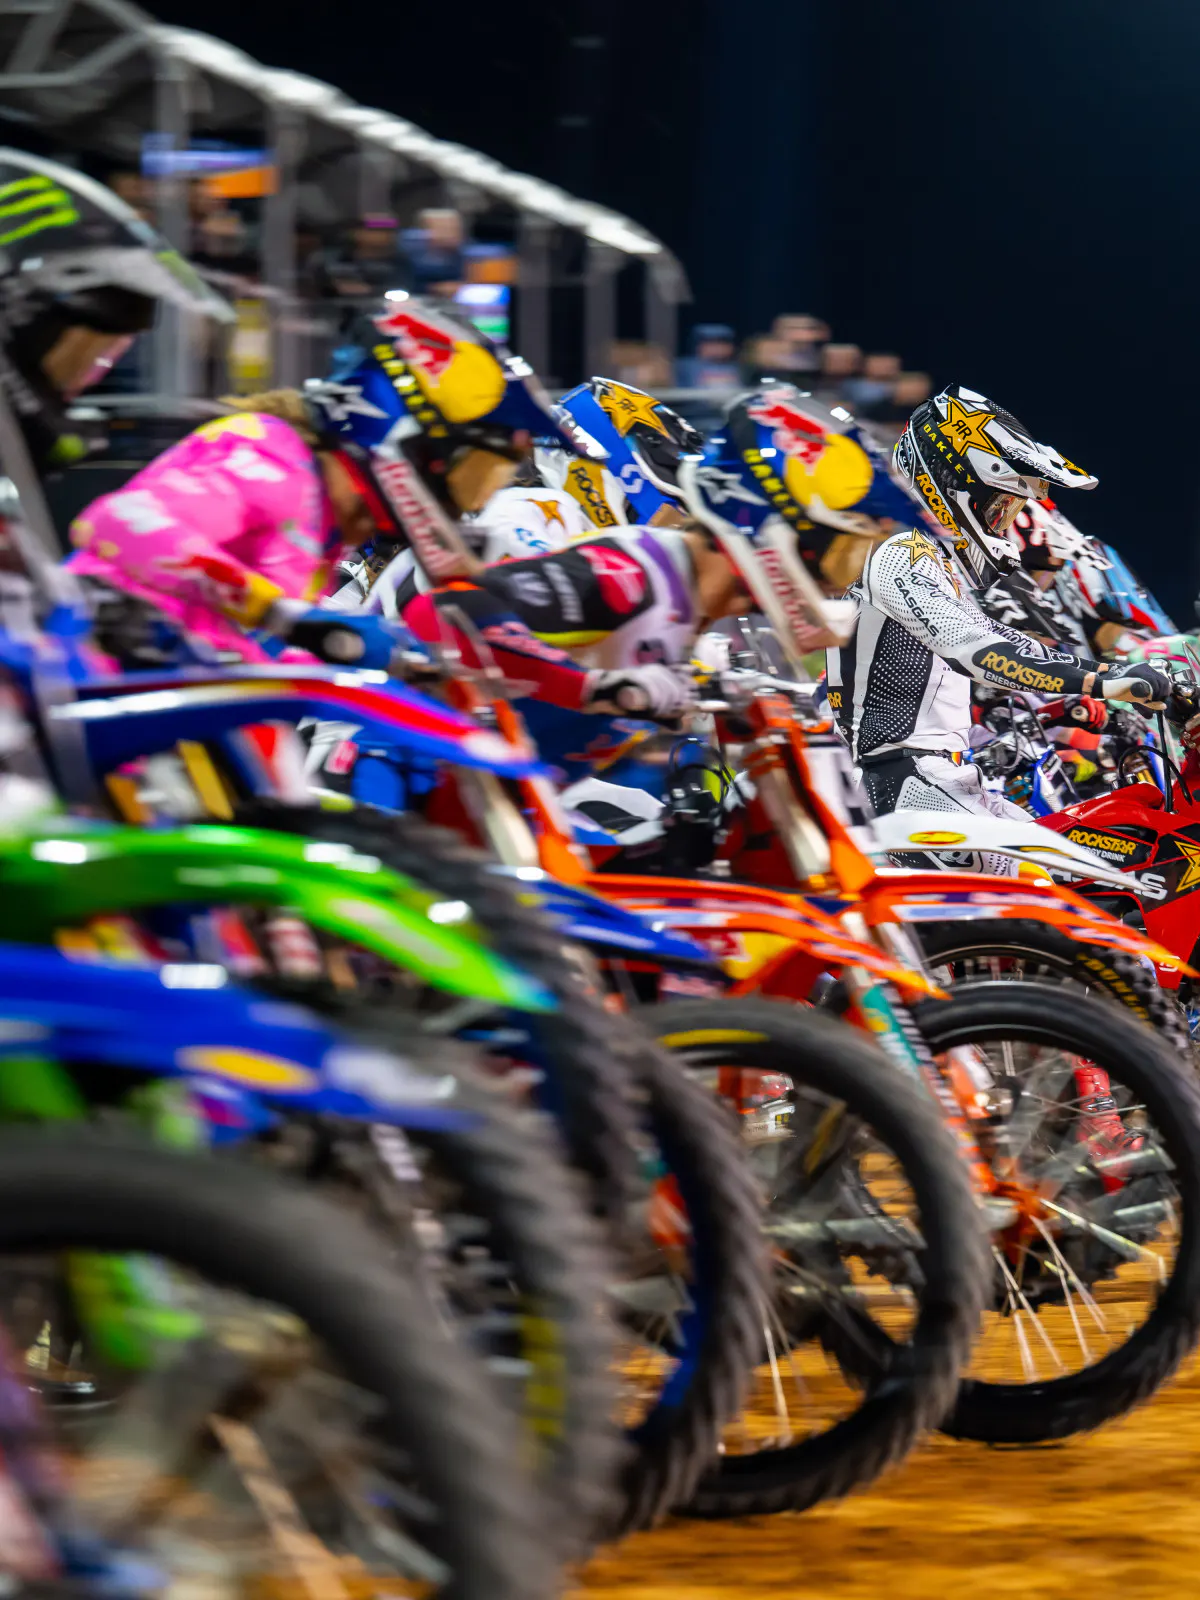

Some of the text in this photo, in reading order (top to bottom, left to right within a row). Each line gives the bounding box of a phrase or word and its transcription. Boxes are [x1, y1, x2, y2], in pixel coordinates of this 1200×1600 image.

[923, 423, 976, 484] OAKLEY
[570, 467, 620, 527] ROCKST
[915, 472, 970, 551] ROCKSTAR
[893, 577, 940, 638] GASGAS
[980, 651, 1065, 693] ROCKSTAR
[986, 671, 1022, 691] ENERGY
[1068, 829, 1137, 856] ROCKSTAR
[1101, 849, 1126, 863] DRINK
